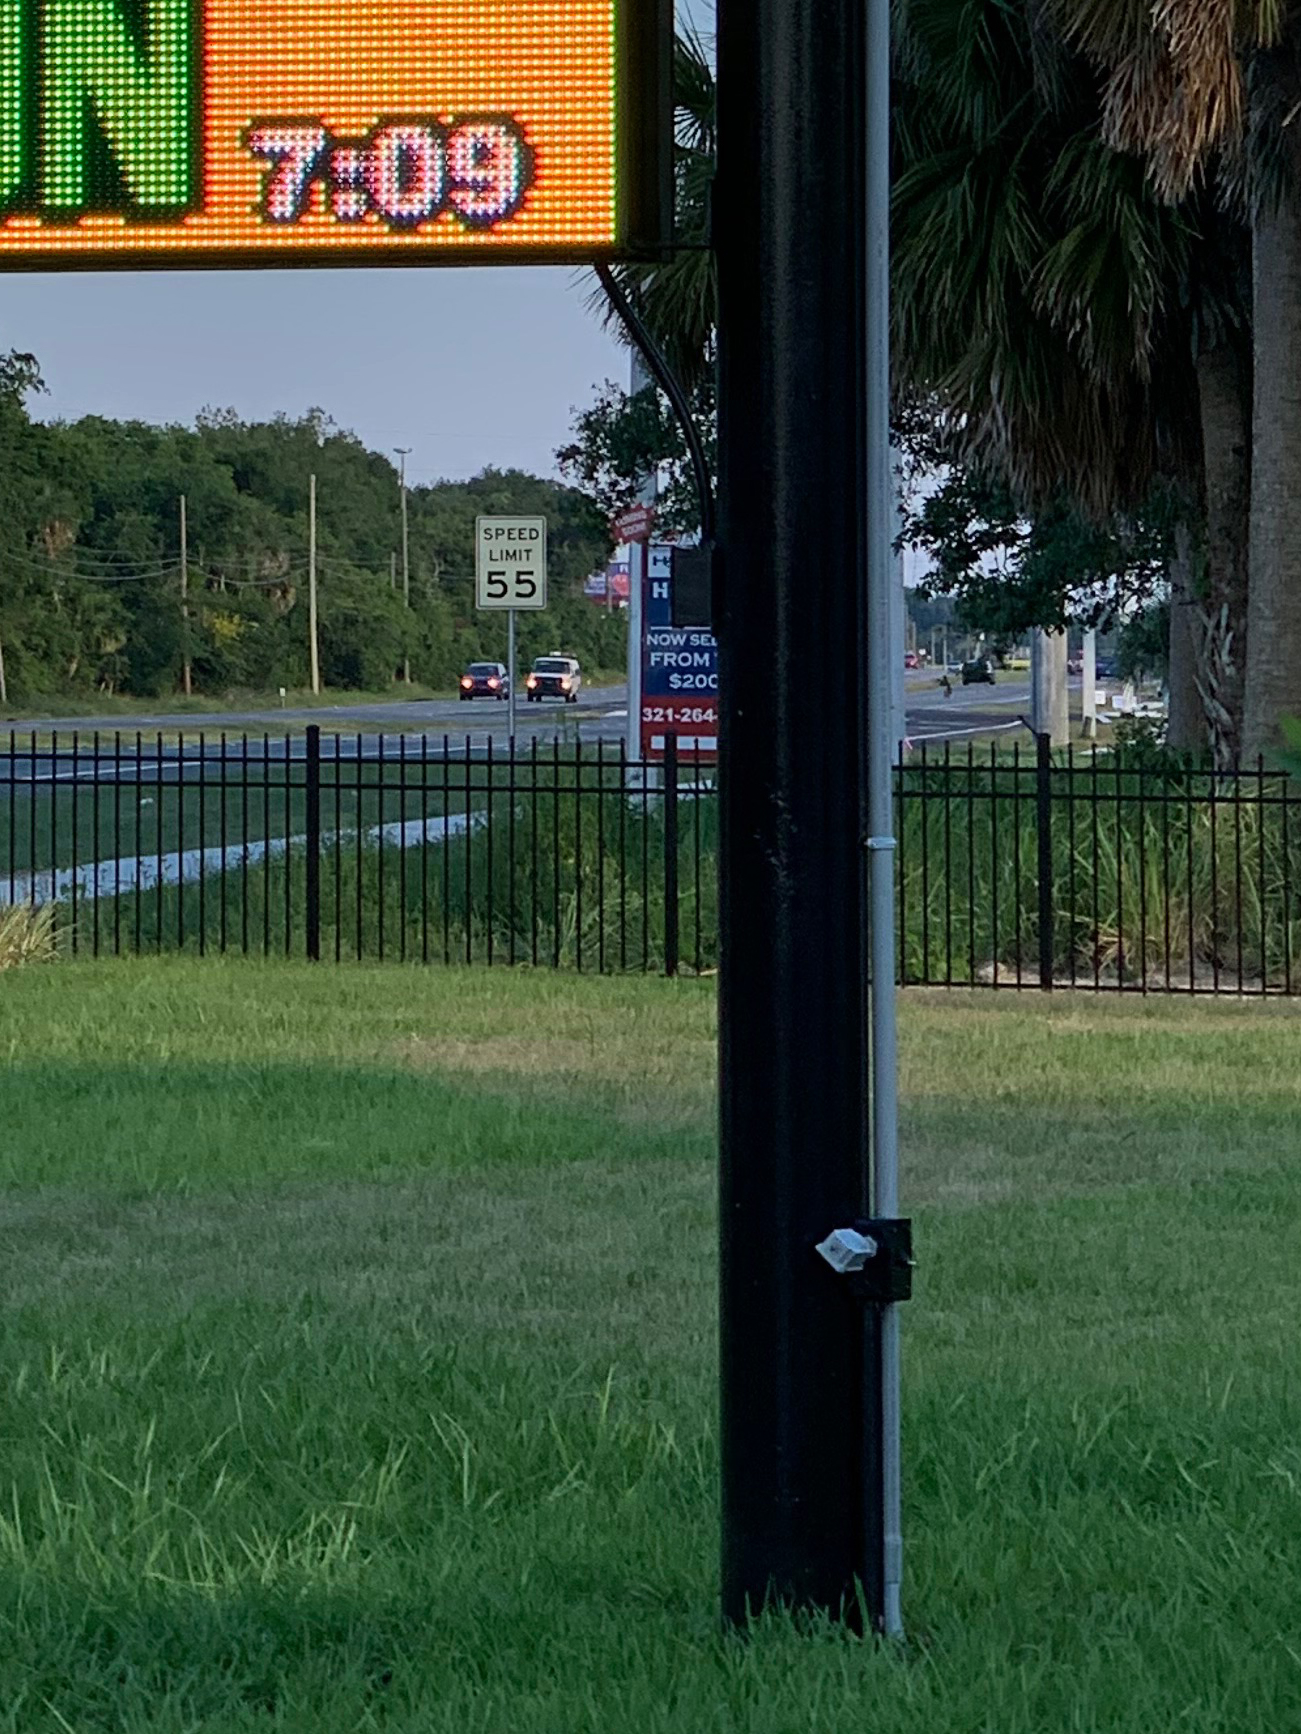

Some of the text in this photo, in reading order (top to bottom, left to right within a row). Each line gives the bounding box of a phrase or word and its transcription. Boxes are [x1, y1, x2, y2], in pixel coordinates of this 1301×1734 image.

[247, 122, 521, 222] 7:09
[483, 527, 540, 541] SPEED
[489, 548, 533, 562] LIMIT
[486, 570, 537, 599] 55
[646, 633, 687, 646] NOW
[650, 652, 710, 667] FROM
